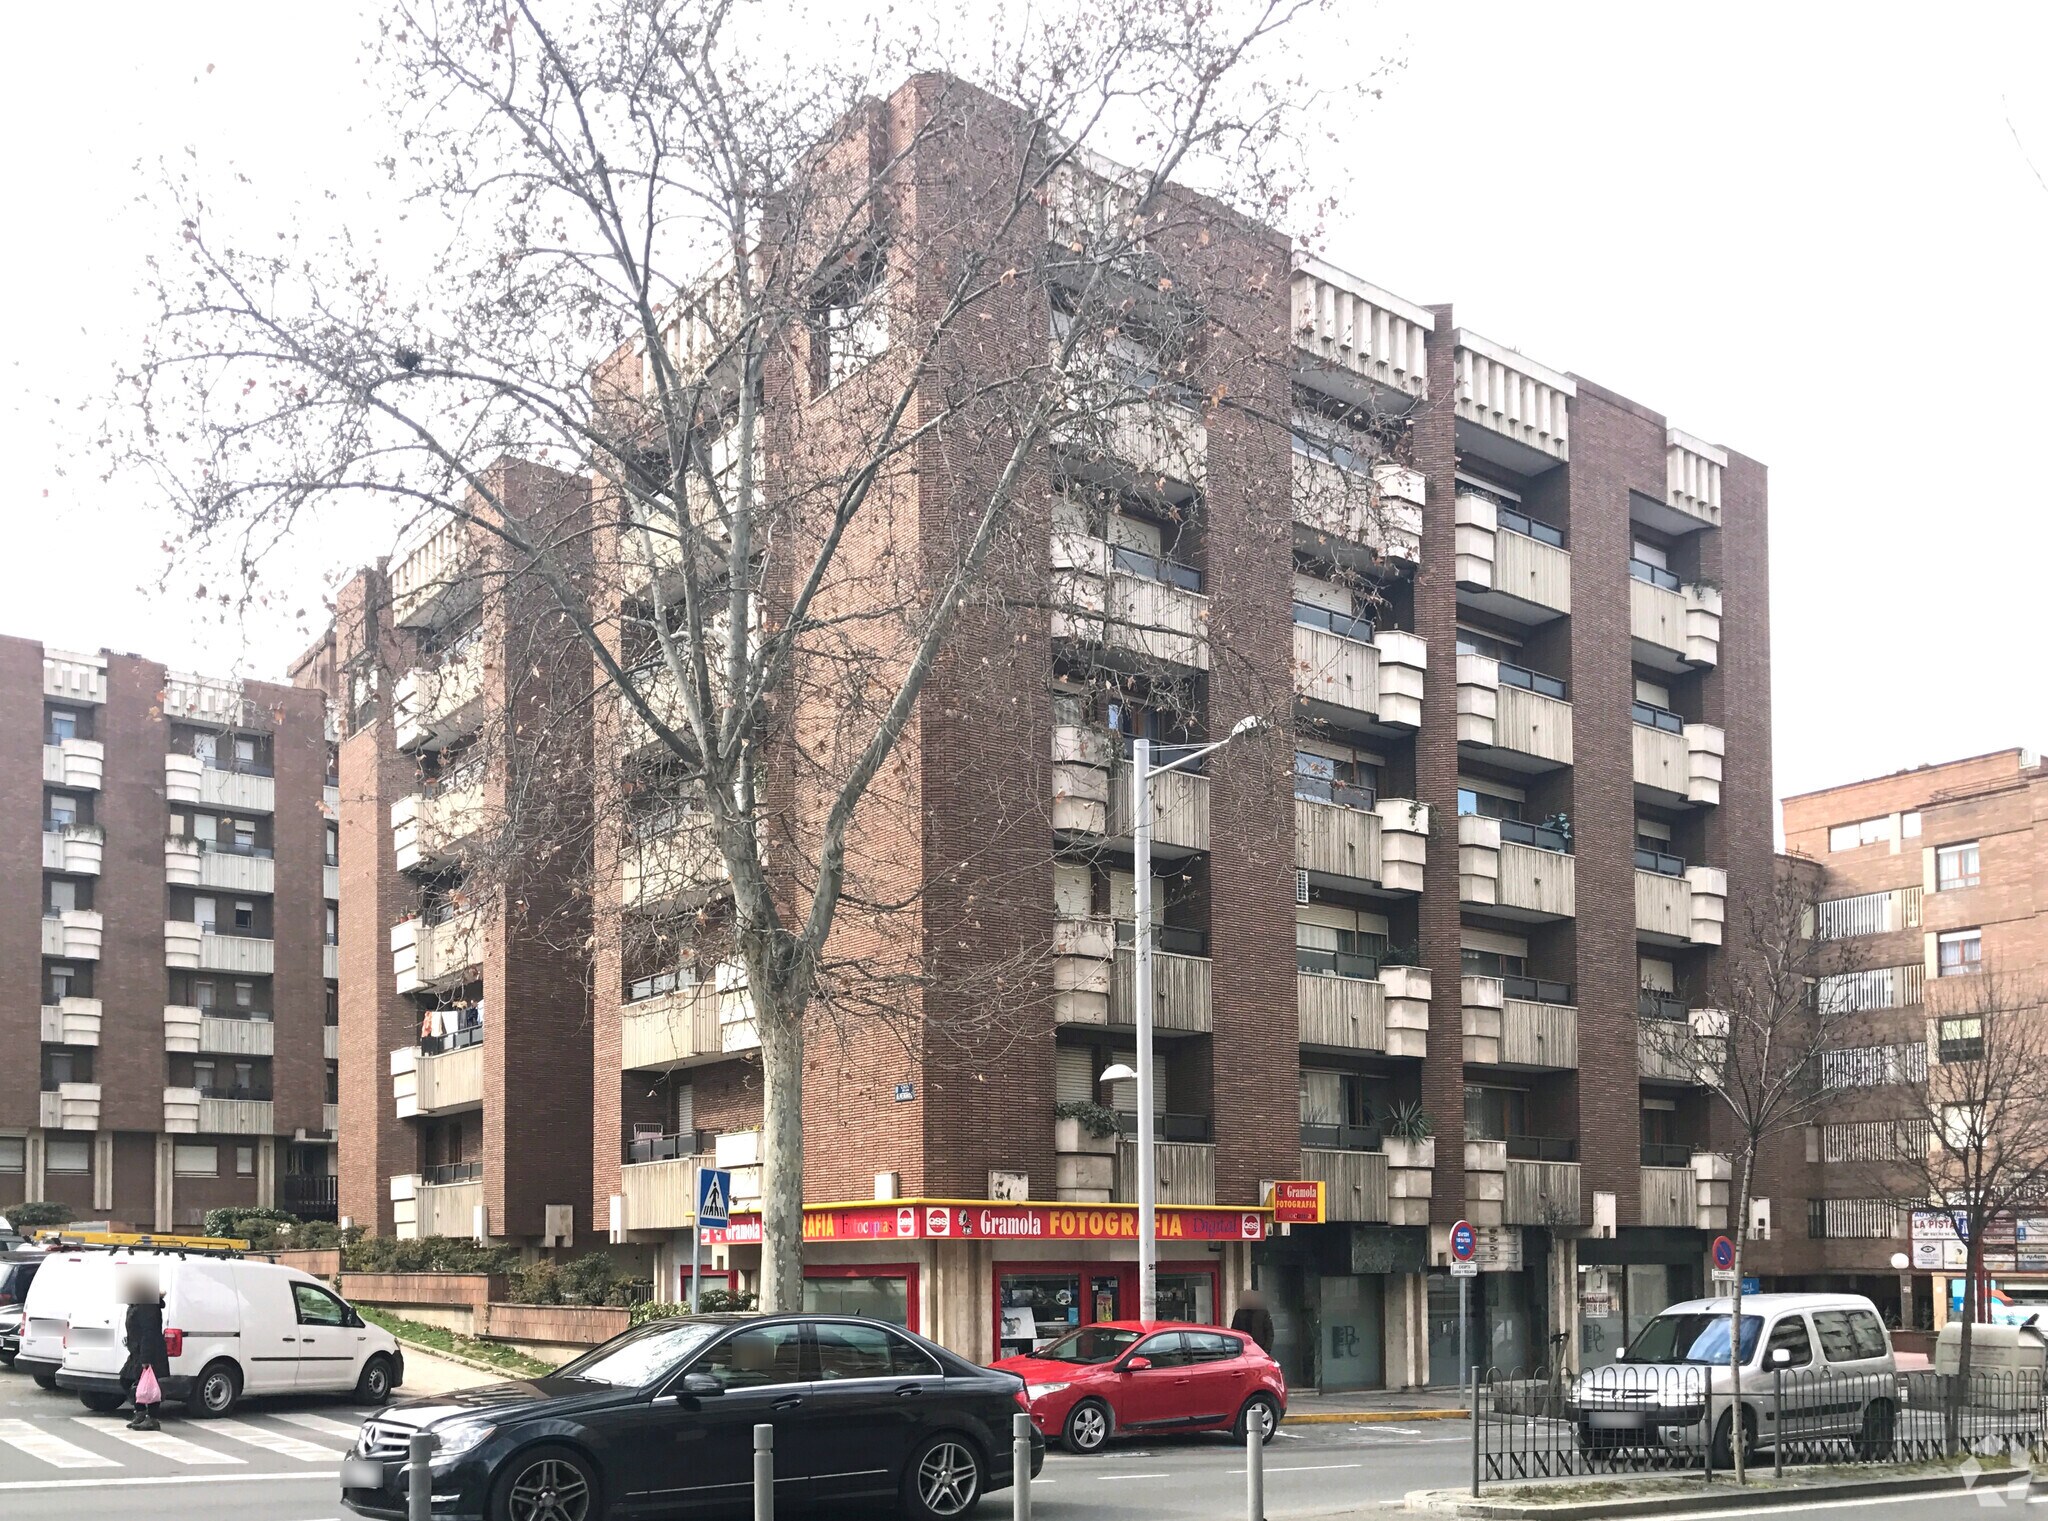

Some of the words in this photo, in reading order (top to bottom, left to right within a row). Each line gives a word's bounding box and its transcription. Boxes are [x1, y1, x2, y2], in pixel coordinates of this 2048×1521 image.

[1286, 1184, 1317, 1198] Gramola
[1276, 1200, 1317, 1209] FOTOGRAFIA
[980, 1209, 1041, 1236] Gramola
[1050, 1211, 1183, 1237] FOTOGRFIA
[1914, 1220, 1926, 1229] LA
